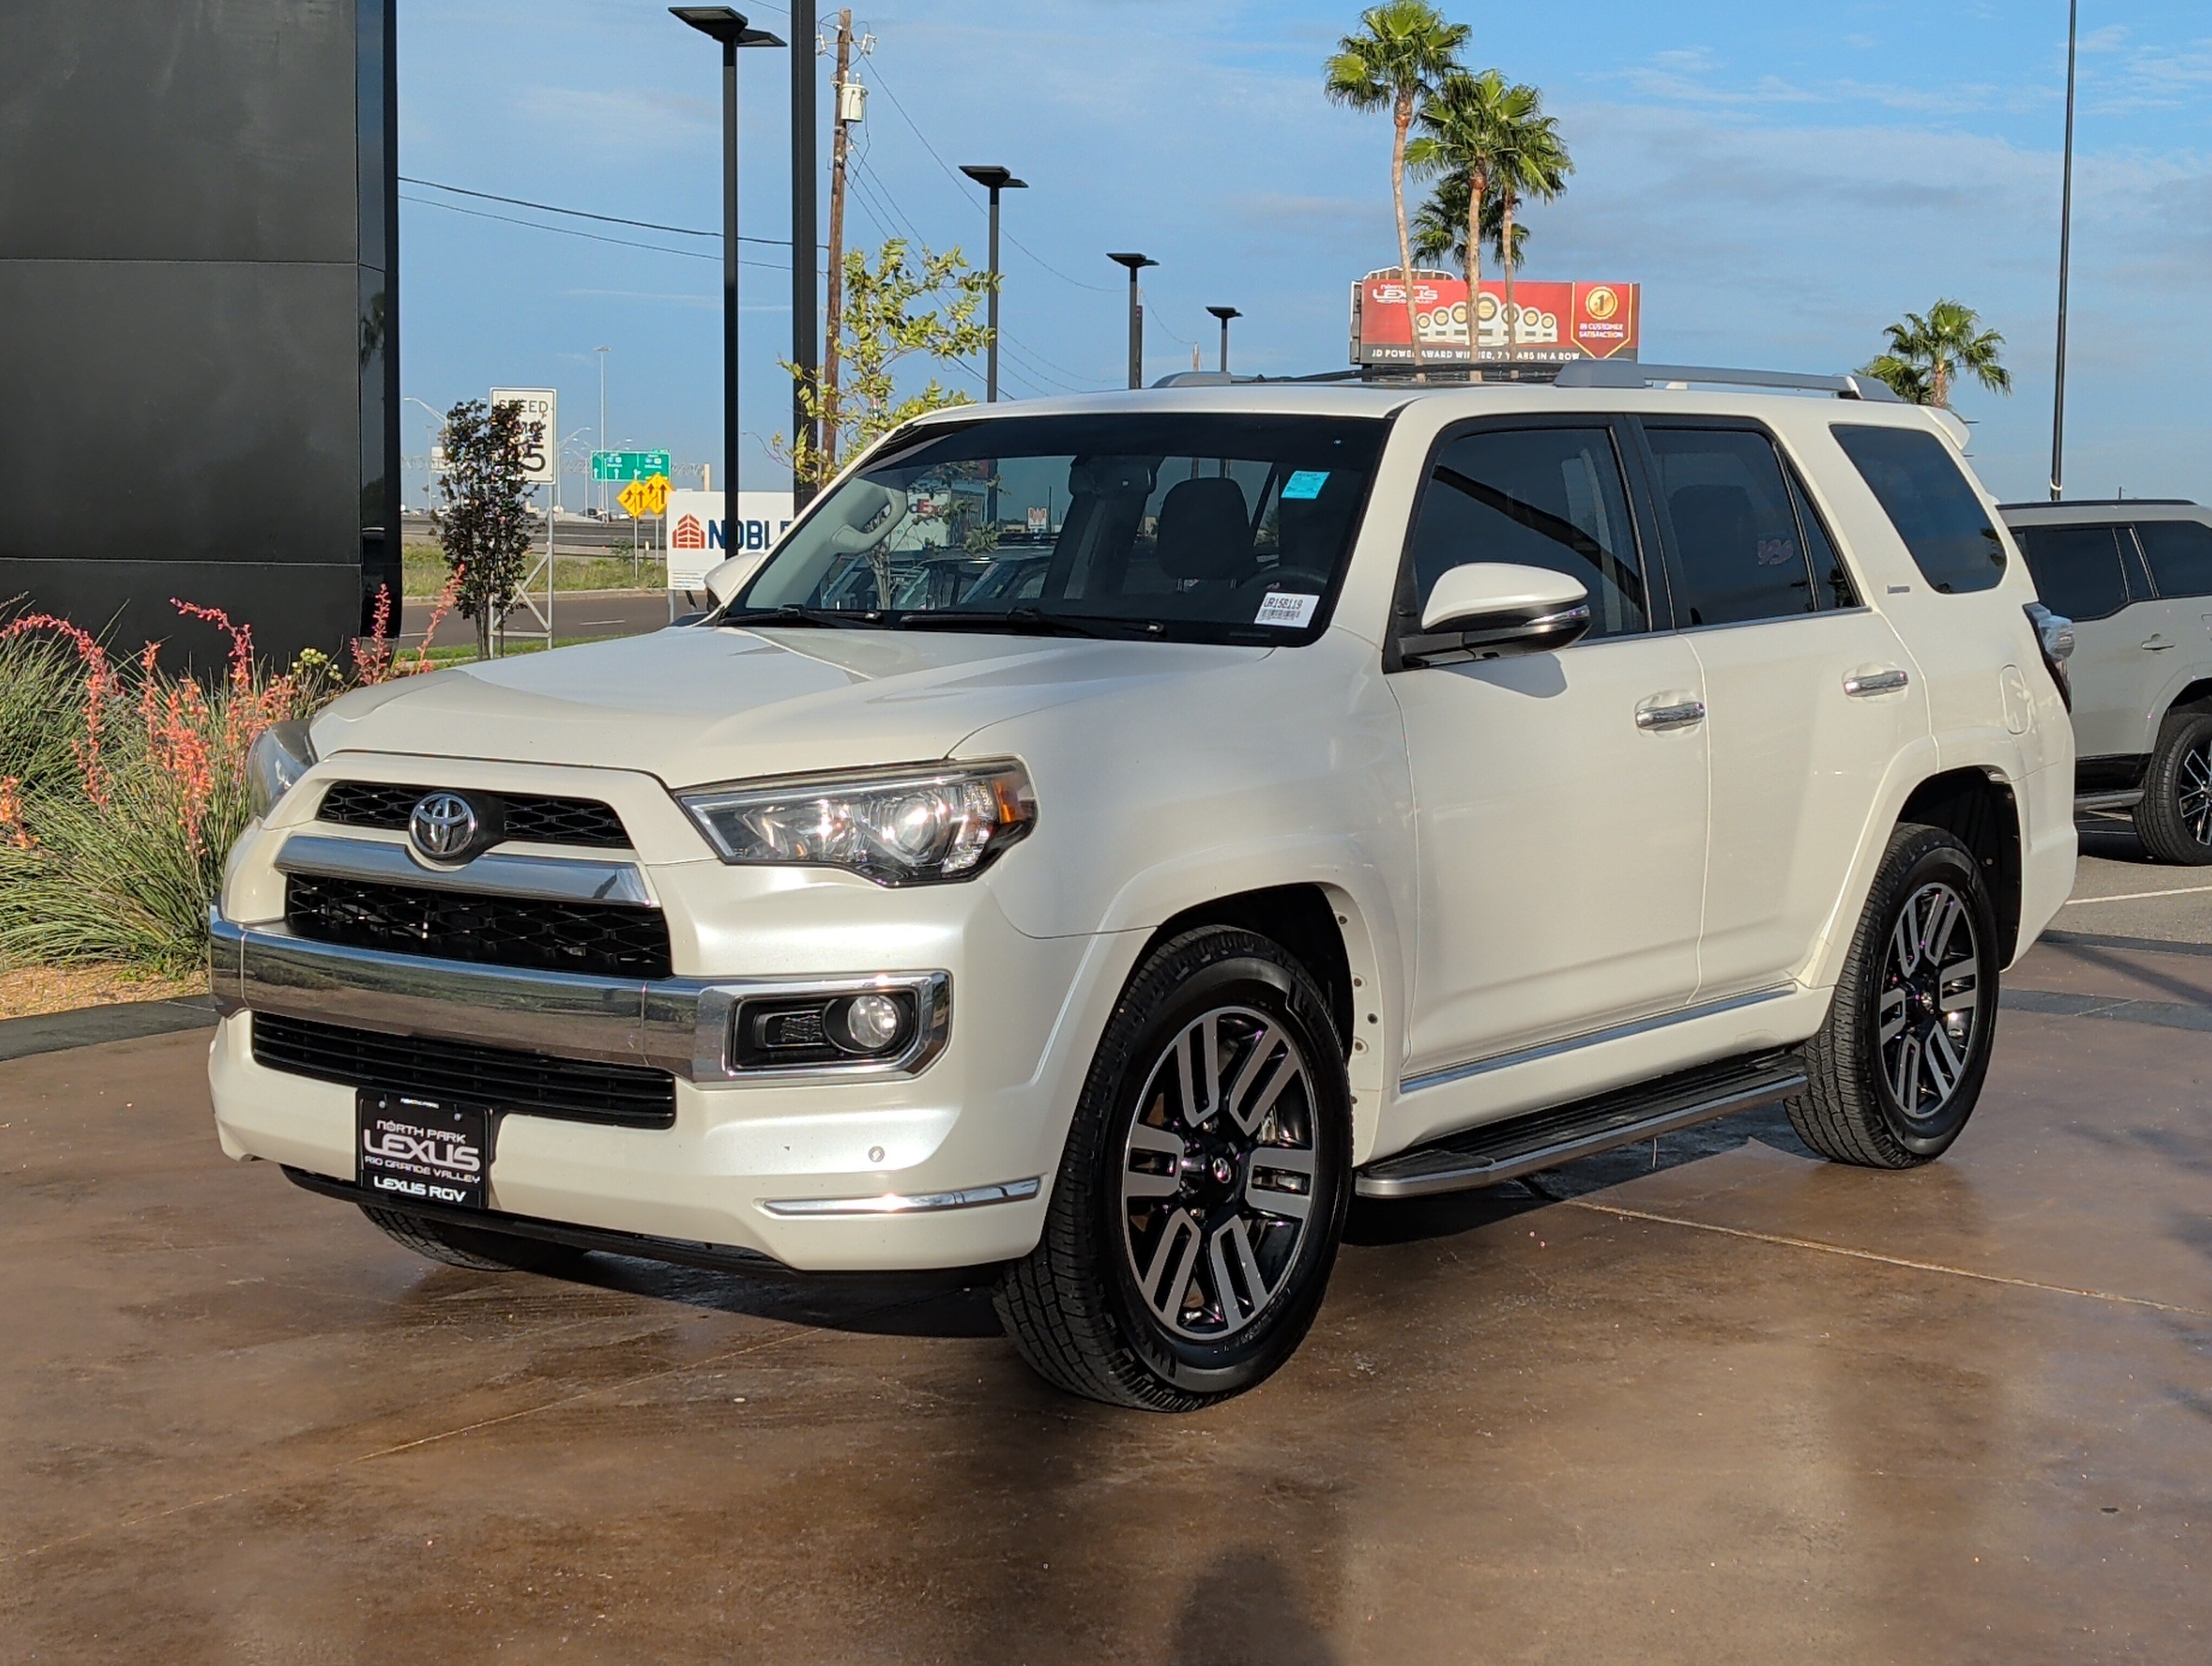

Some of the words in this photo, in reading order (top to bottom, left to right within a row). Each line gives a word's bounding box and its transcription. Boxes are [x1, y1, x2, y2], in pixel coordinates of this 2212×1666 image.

[1372, 289, 1438, 300] LEXUS
[1372, 349, 1382, 358] JD
[1497, 351, 1502, 359] 7
[1506, 351, 1535, 360] YARS
[1537, 351, 1547, 360] IN
[1549, 351, 1557, 360] A
[1558, 352, 1580, 360] ROW
[376, 1119, 424, 1137] NORTH
[427, 1129, 466, 1145] PARK
[364, 1129, 481, 1172] LEXUS
[365, 1155, 383, 1166] RIO
[385, 1159, 432, 1176] GRANDE
[433, 1168, 481, 1184] VALLEY
[374, 1175, 427, 1196] LEXUS
[429, 1185, 467, 1203] RGV
